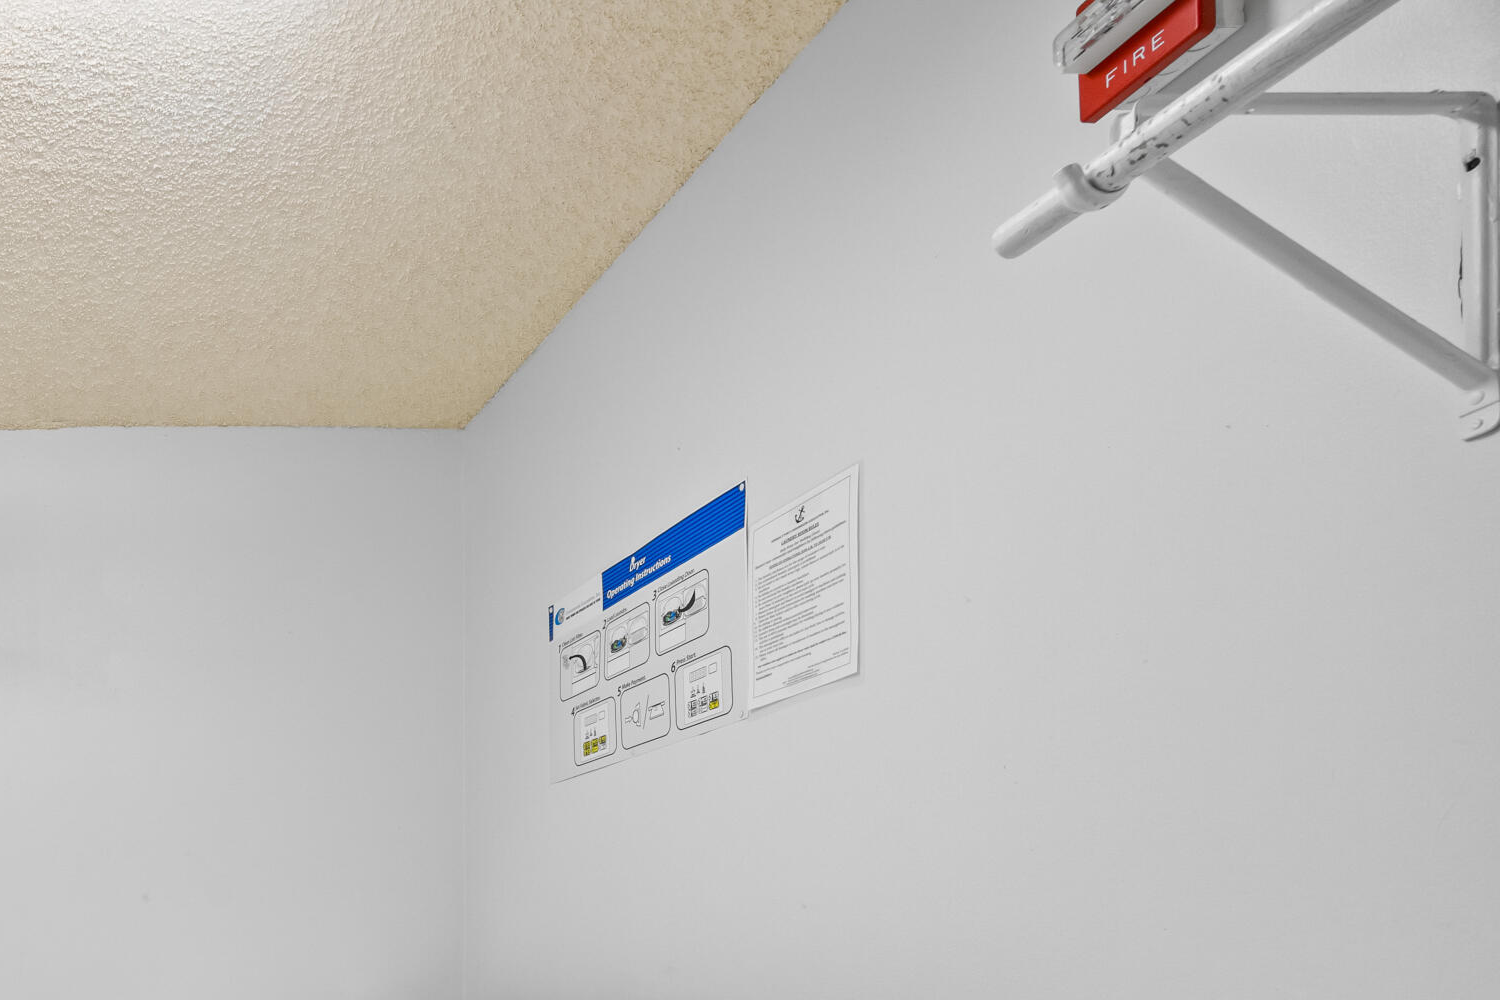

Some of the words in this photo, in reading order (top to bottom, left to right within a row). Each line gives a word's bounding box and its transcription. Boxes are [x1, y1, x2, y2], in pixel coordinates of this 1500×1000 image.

[1105, 29, 1165, 89] FIRE
[628, 556, 647, 573] Dryer
[606, 575, 635, 600] Operating
[635, 555, 671, 581] Instructions
[652, 589, 657, 601] 3
[671, 660, 676, 673] 6
[617, 685, 621, 697] 5
